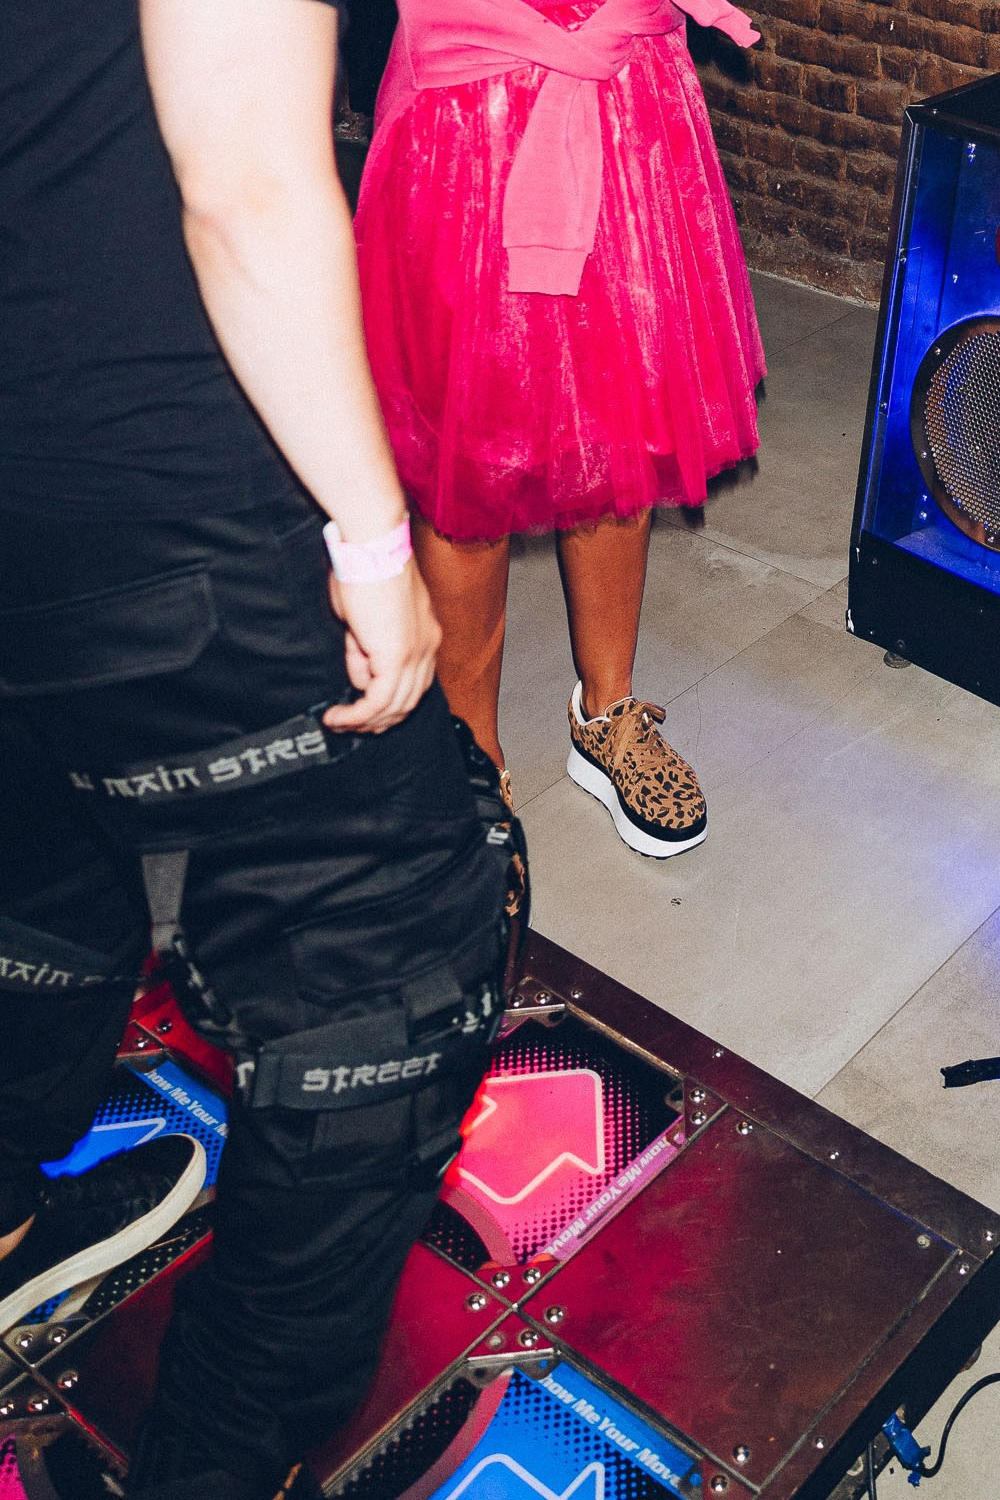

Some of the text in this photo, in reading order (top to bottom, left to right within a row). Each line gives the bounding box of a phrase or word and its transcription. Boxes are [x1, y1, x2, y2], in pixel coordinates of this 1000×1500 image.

[301, 1051, 442, 1095] STREET
[168, 1087, 192, 1106] Me
[186, 1100, 219, 1126] Your
[571, 1399, 601, 1425] Me
[597, 1416, 640, 1452] Your
